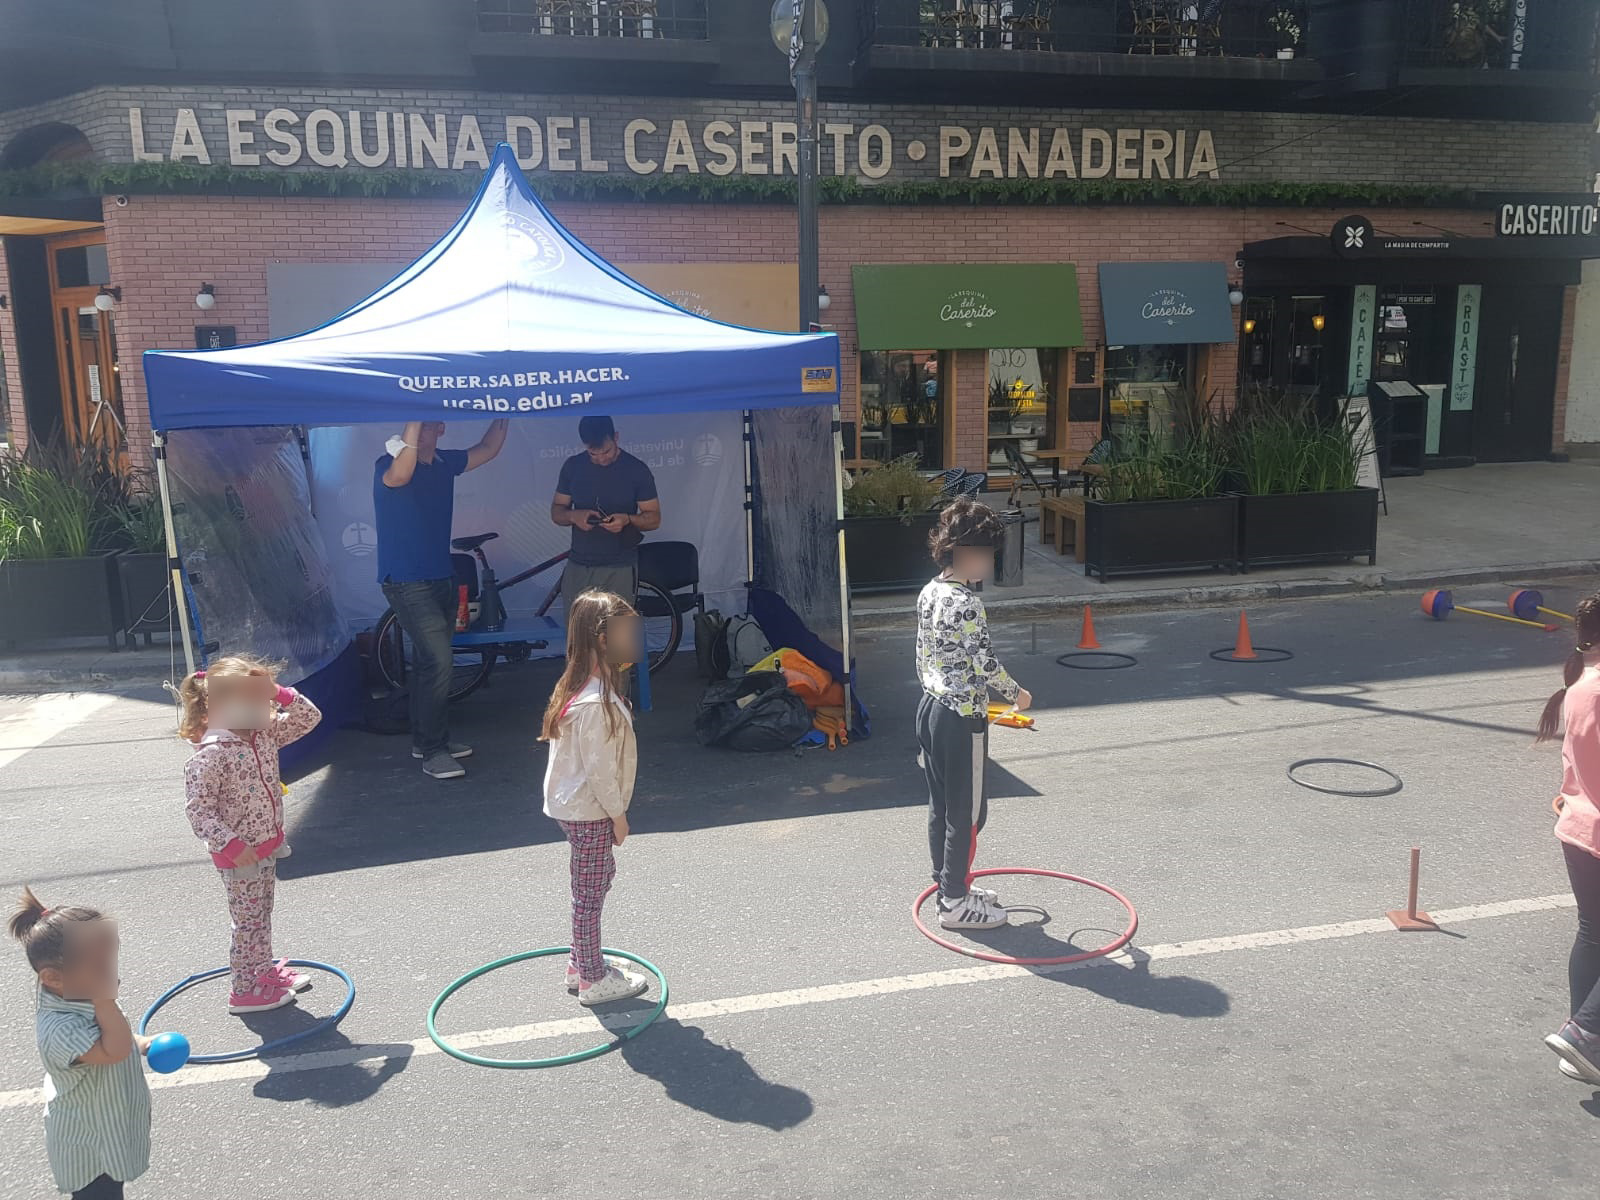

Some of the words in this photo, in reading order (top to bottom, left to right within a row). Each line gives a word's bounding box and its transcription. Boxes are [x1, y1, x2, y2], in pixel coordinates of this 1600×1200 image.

[129, 107, 211, 165] LA
[226, 108, 490, 170] ESQUINA
[505, 115, 609, 172] DEL
[624, 118, 893, 179] CASERTO
[939, 126, 1221, 179] PANADERIA
[1501, 204, 1594, 235] CASERITO
[940, 304, 997, 321] Caserito
[960, 297, 976, 307] del
[1142, 302, 1196, 319] Caserito
[1161, 295, 1176, 306] del
[1356, 309, 1367, 378] CAFÉ
[1459, 305, 1472, 383] ROAST
